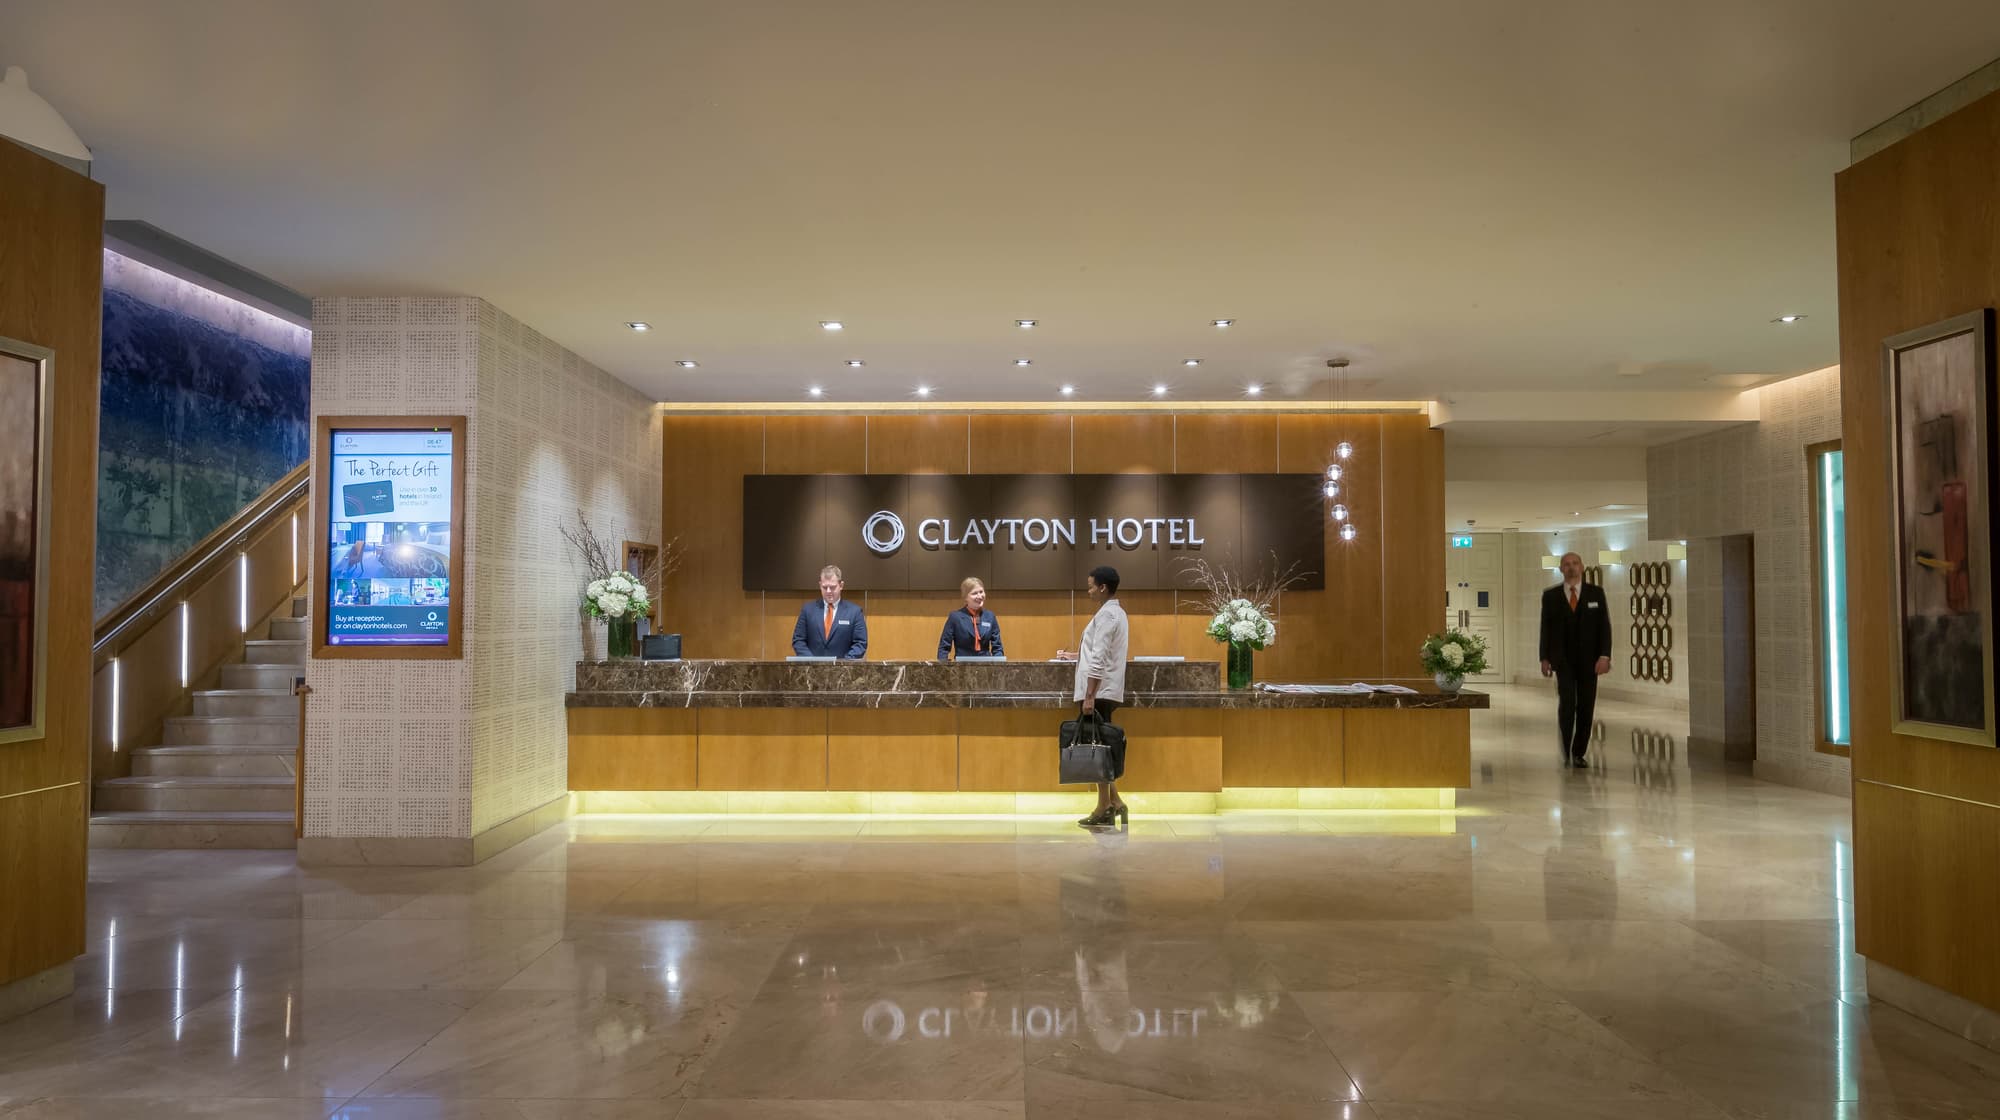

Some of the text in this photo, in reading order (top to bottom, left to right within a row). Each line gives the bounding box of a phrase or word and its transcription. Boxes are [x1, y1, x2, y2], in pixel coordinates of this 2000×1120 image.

[344, 459, 440, 477] The Perfect Gift
[918, 518, 1205, 546] CLAYTON HOTEL
[335, 615, 346, 623] Buy
[355, 615, 385, 623] reception
[352, 622, 408, 630] claytonhotels.com
